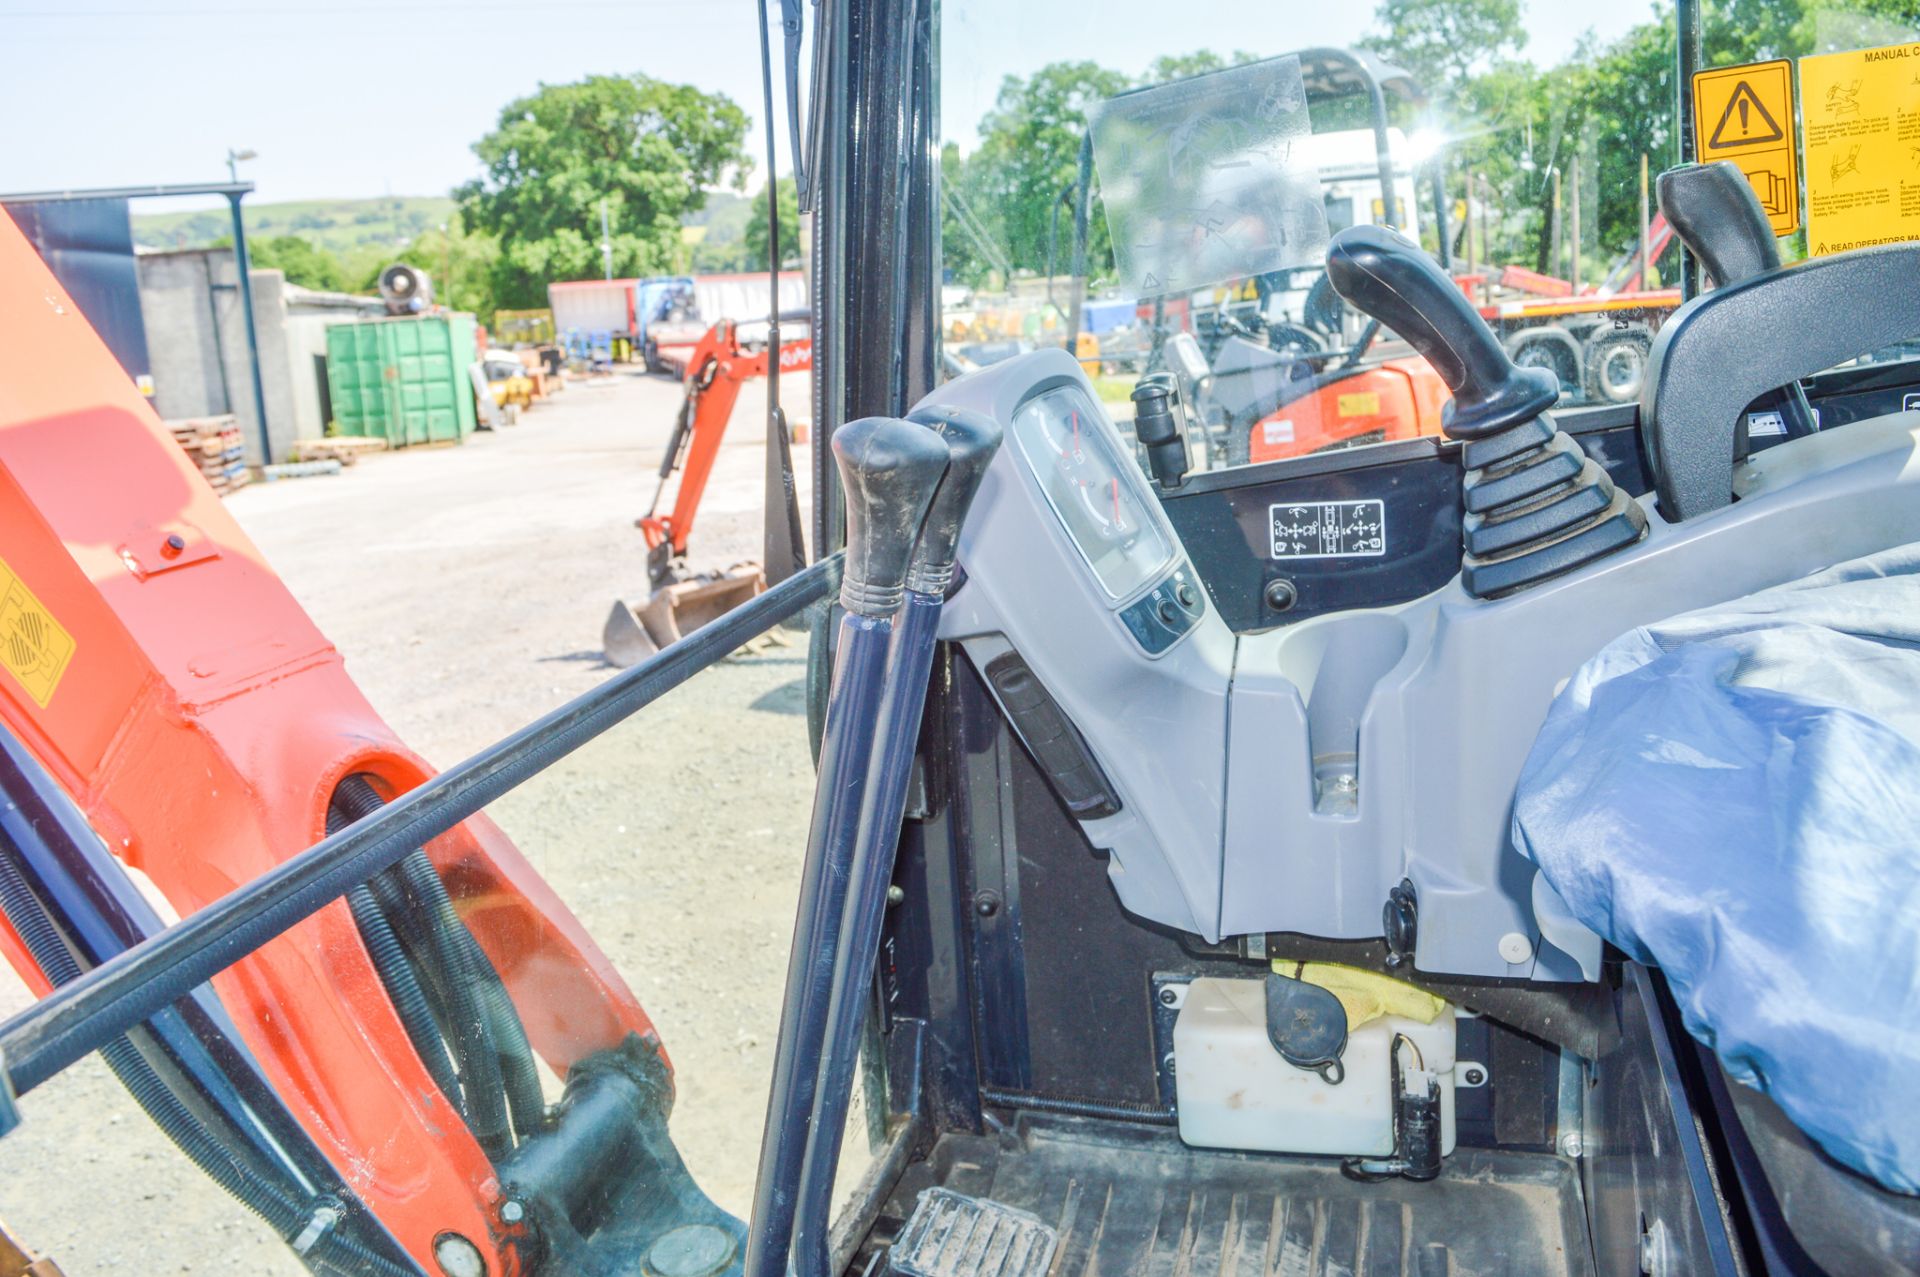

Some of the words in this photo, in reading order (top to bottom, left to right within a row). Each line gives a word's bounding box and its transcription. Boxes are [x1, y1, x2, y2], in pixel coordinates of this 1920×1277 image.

[1865, 48, 1910, 62] MANUAL
[1831, 242, 1854, 252] READ
[1855, 236, 1905, 249] OPERATORS
